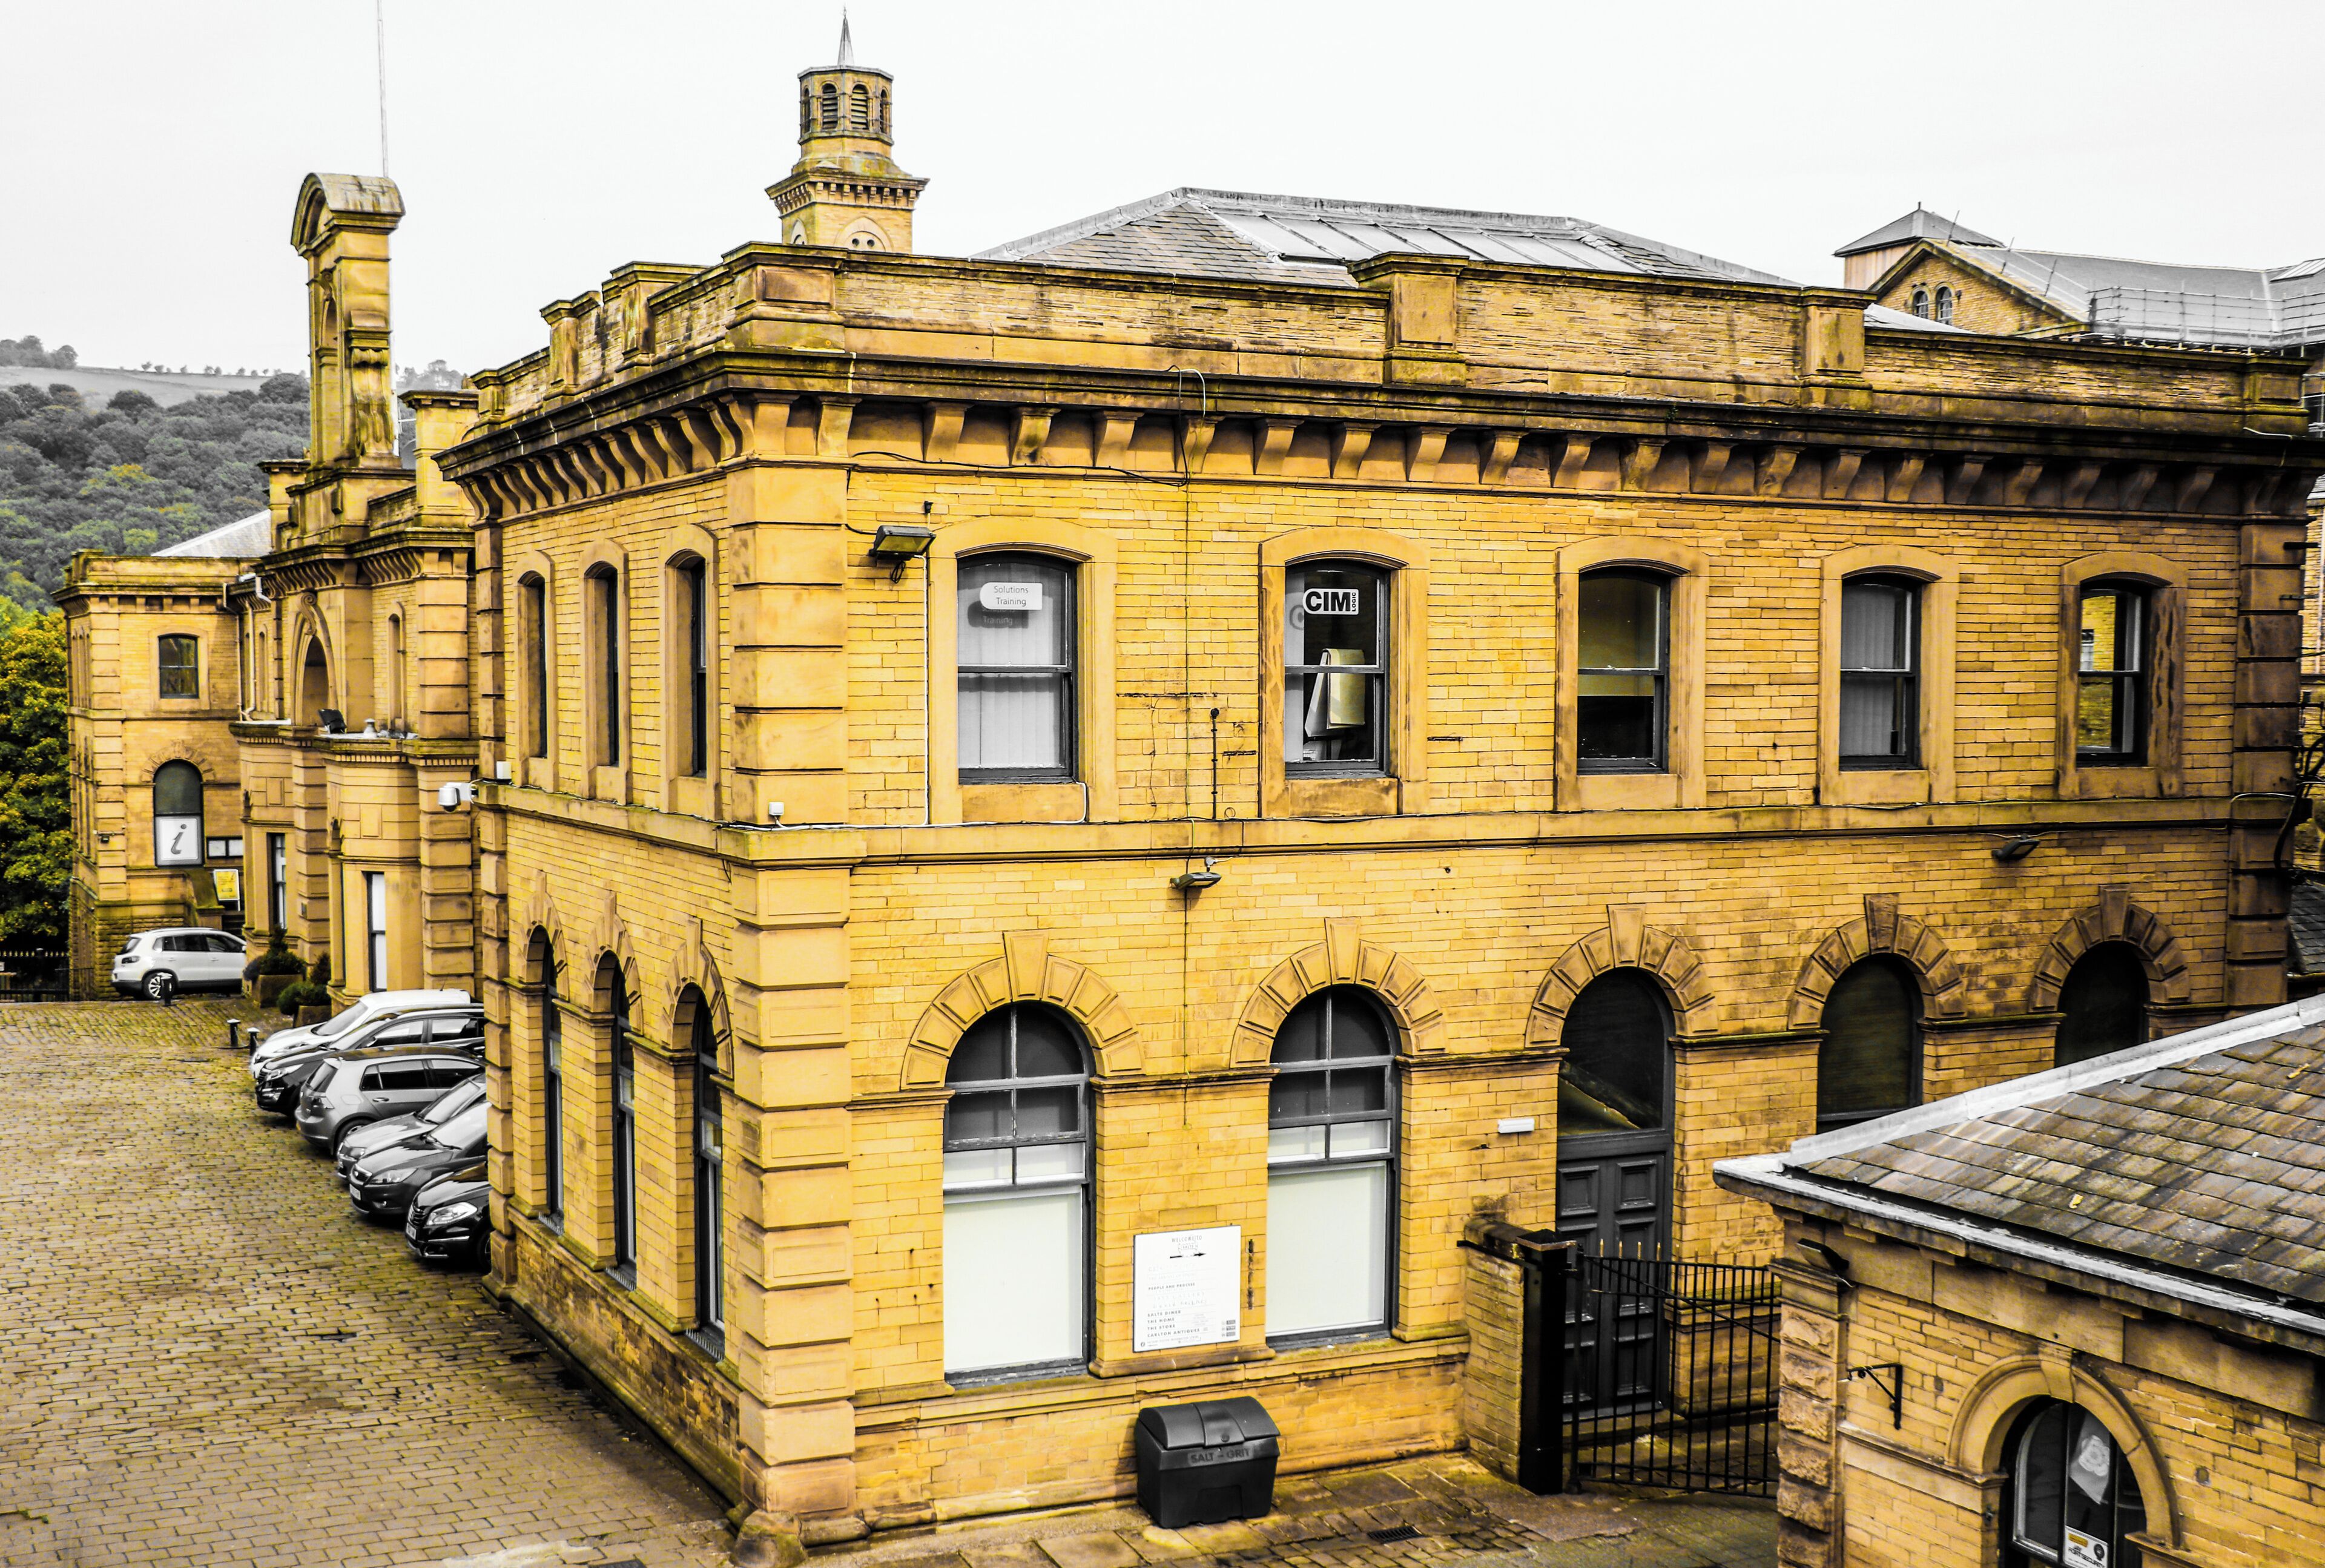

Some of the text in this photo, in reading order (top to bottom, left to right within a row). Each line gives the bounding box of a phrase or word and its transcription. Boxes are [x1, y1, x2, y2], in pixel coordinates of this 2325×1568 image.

[994, 585, 1029, 594] Solutions
[996, 597, 1026, 607] Training
[1305, 591, 1351, 611] CIM
[1190, 1452, 1215, 1464] SALT
[1227, 1448, 1250, 1459] GRIT
